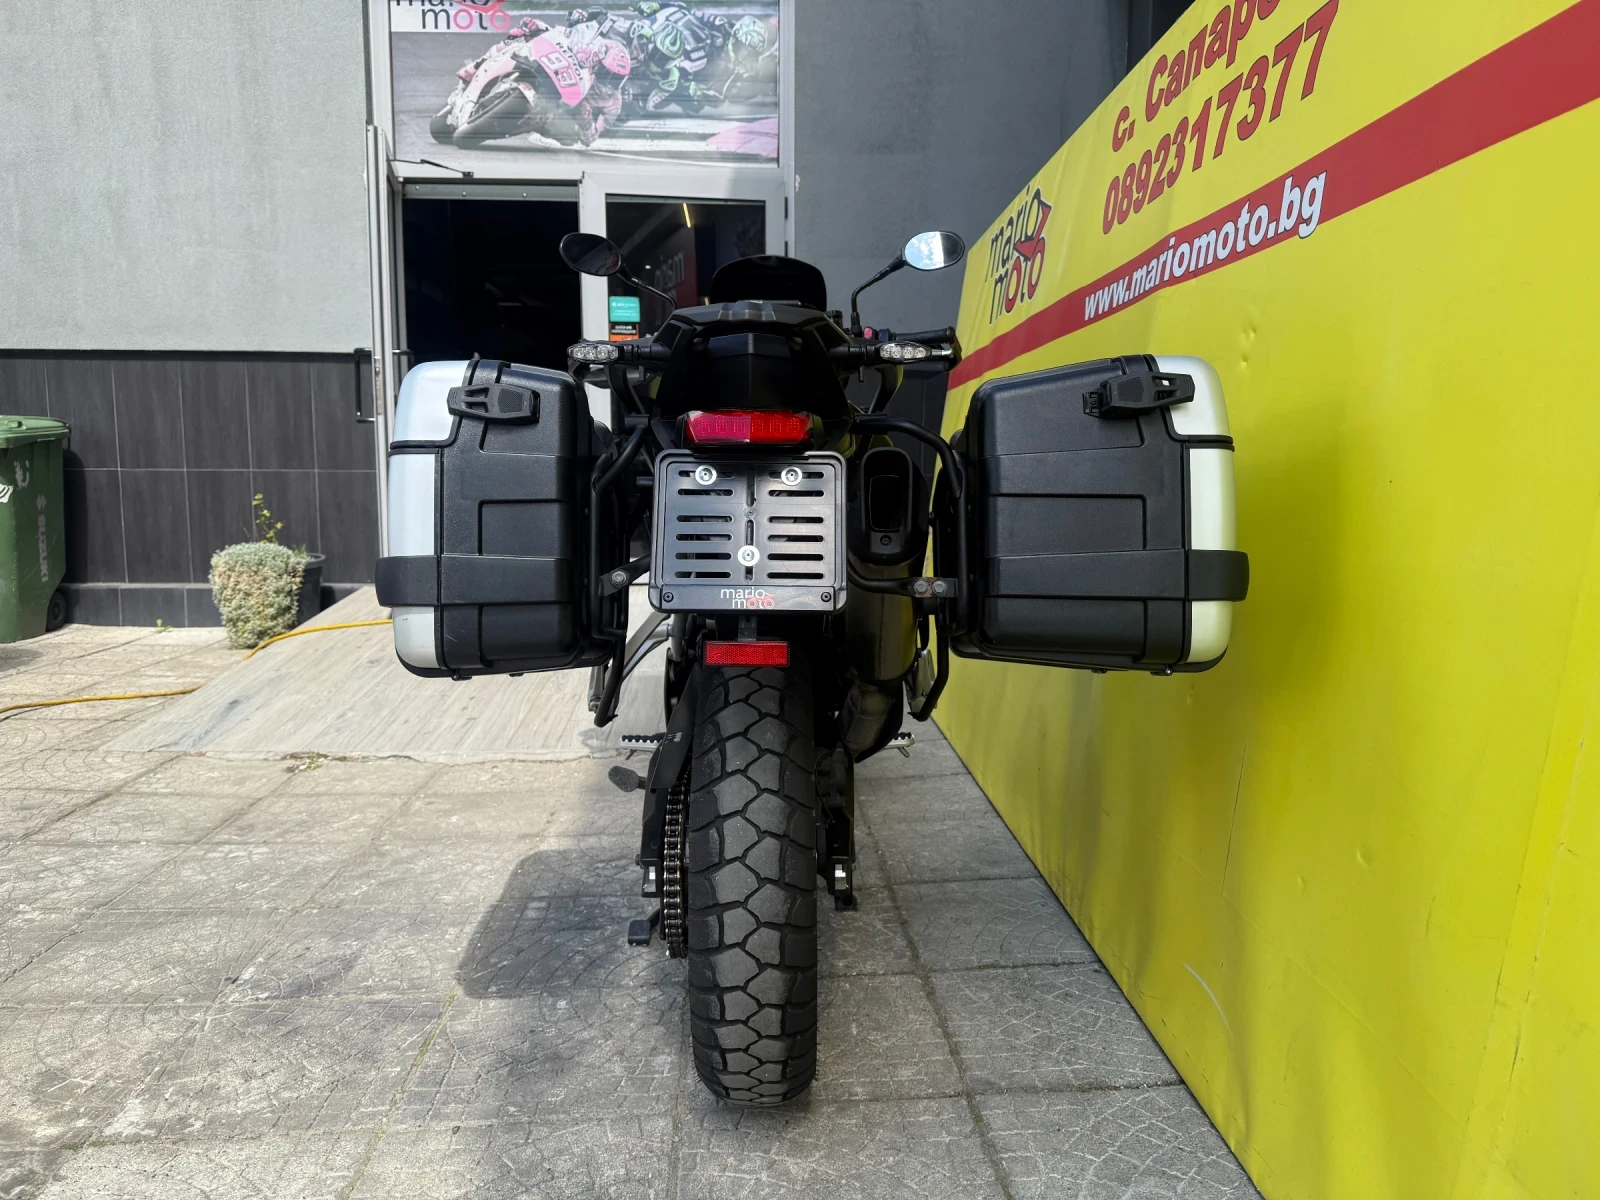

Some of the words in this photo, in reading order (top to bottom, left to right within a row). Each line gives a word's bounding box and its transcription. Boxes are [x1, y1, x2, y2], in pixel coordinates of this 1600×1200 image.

[421, 8, 511, 31] moto
[1102, 0, 1340, 236] 0892317377
[988, 185, 1042, 279] mario
[1084, 171, 1328, 321] www.mariomoto.bg
[990, 235, 1046, 324] moto
[38, 514, 49, 582] SUZUKI
[720, 586, 765, 599] mario
[732, 596, 775, 608] moto
